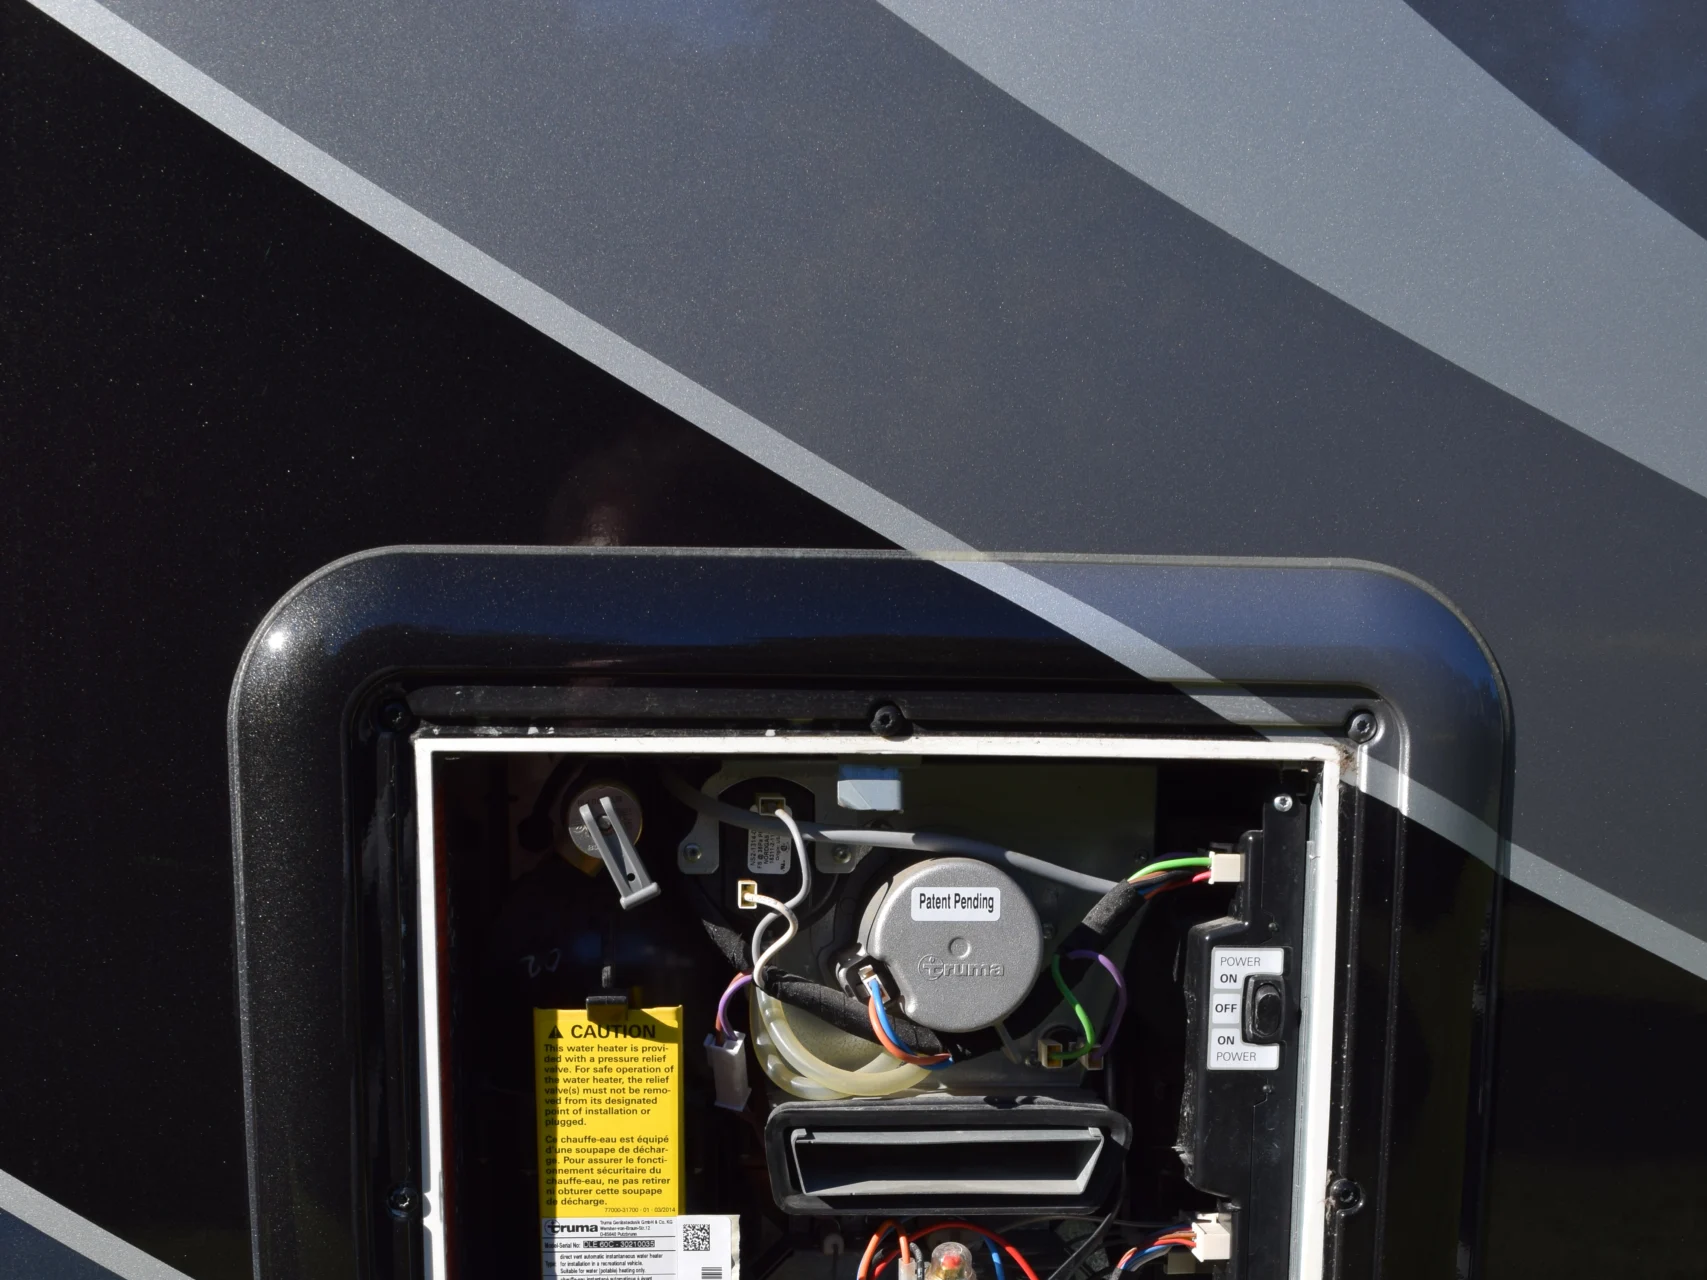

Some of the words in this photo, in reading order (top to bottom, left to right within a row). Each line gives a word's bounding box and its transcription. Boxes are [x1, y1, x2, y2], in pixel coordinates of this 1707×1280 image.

[920, 893, 951, 909] Patent
[954, 893, 994, 913] Pending
[1220, 957, 1260, 966] POWER
[918, 954, 1004, 980] truma
[1220, 974, 1237, 983] ON
[1215, 1003, 1237, 1013] OFF
[571, 1024, 655, 1038] CAUTION
[1218, 1036, 1235, 1045] ON
[544, 1044, 563, 1052] This
[642, 1044, 668, 1053] provi-
[1216, 1052, 1256, 1061] POWER
[544, 1065, 571, 1073] valve.
[616, 1065, 661, 1074] operation
[593, 1076, 624, 1084] heater,
[544, 1086, 579, 1095] valve(s)
[605, 1097, 657, 1106] designated
[545, 1107, 569, 1116] point
[545, 1118, 586, 1127] plugged.
[545, 1135, 557, 1143] Ce
[637, 1135, 668, 1144] équipé
[545, 1146, 572, 1154] d'une
[561, 1198, 607, 1206] décharge.
[545, 1220, 598, 1235] truma
